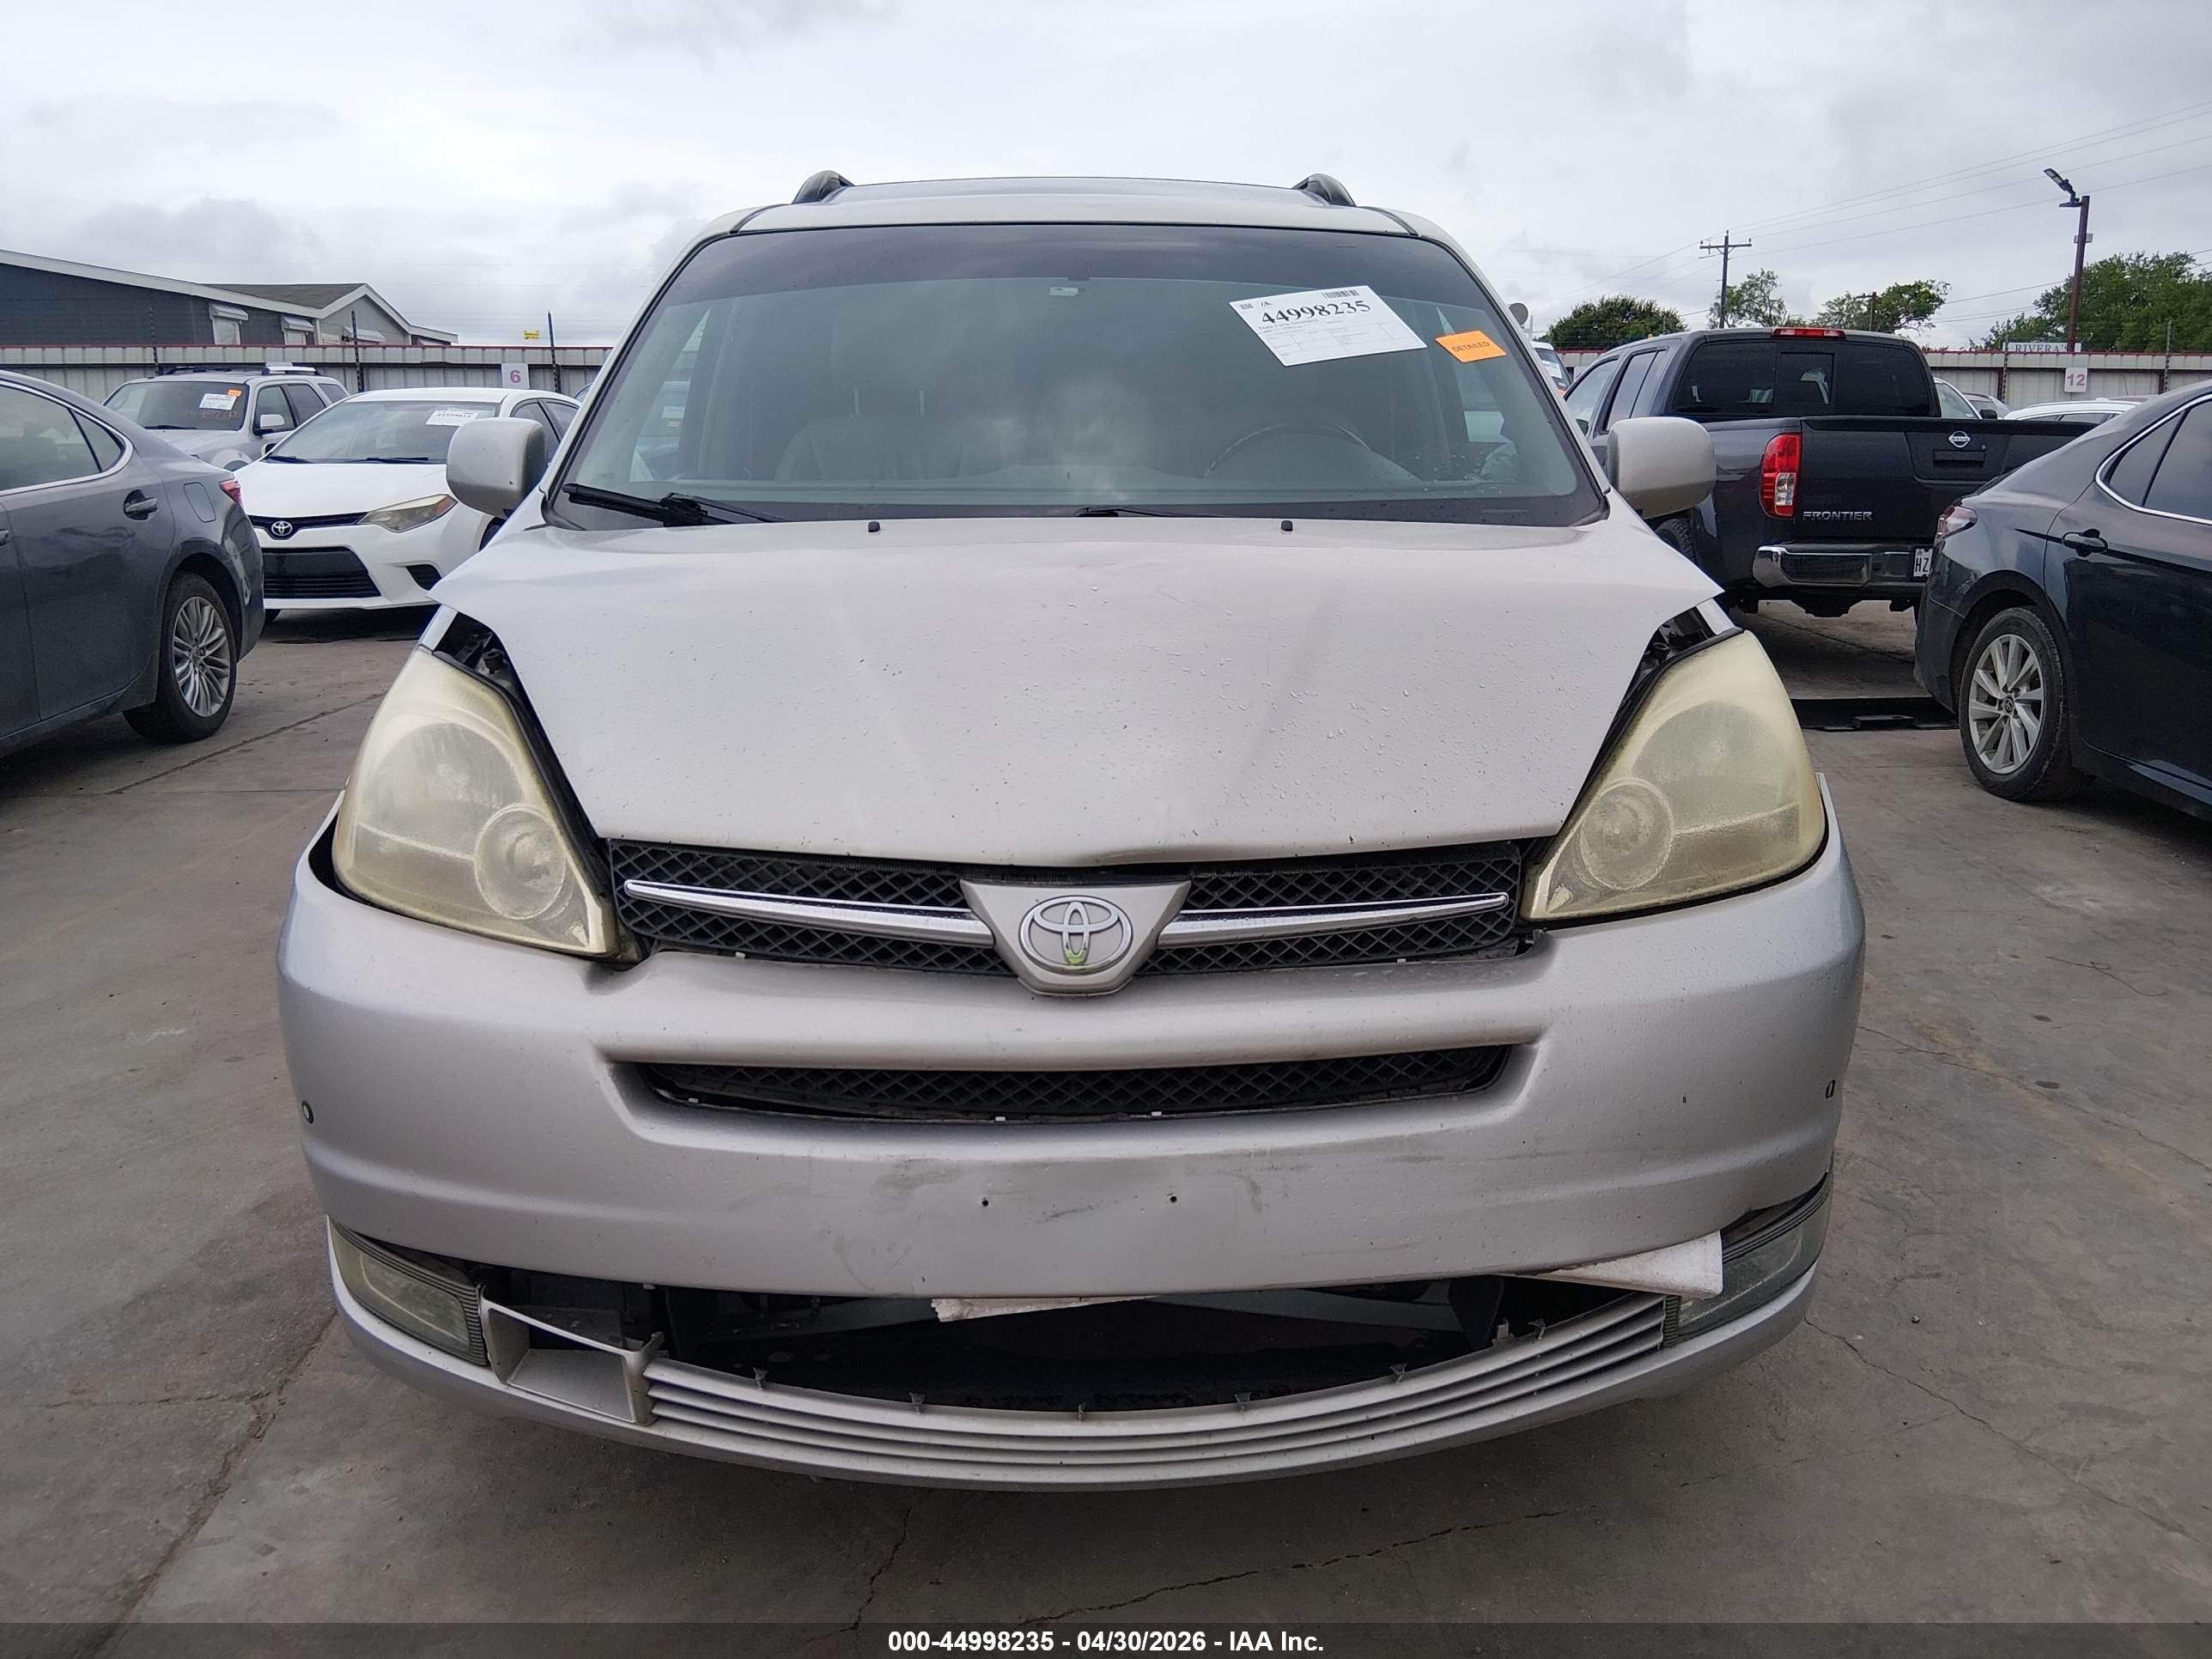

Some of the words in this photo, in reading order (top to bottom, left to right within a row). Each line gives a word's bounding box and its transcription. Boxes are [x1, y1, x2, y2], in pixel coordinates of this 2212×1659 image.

[1261, 301, 1370, 324] 44998235
[1451, 341, 1491, 353] DETAILED
[509, 369, 521, 384] 6
[2067, 373, 2086, 386] 12
[1802, 511, 1873, 521] FRONTIER
